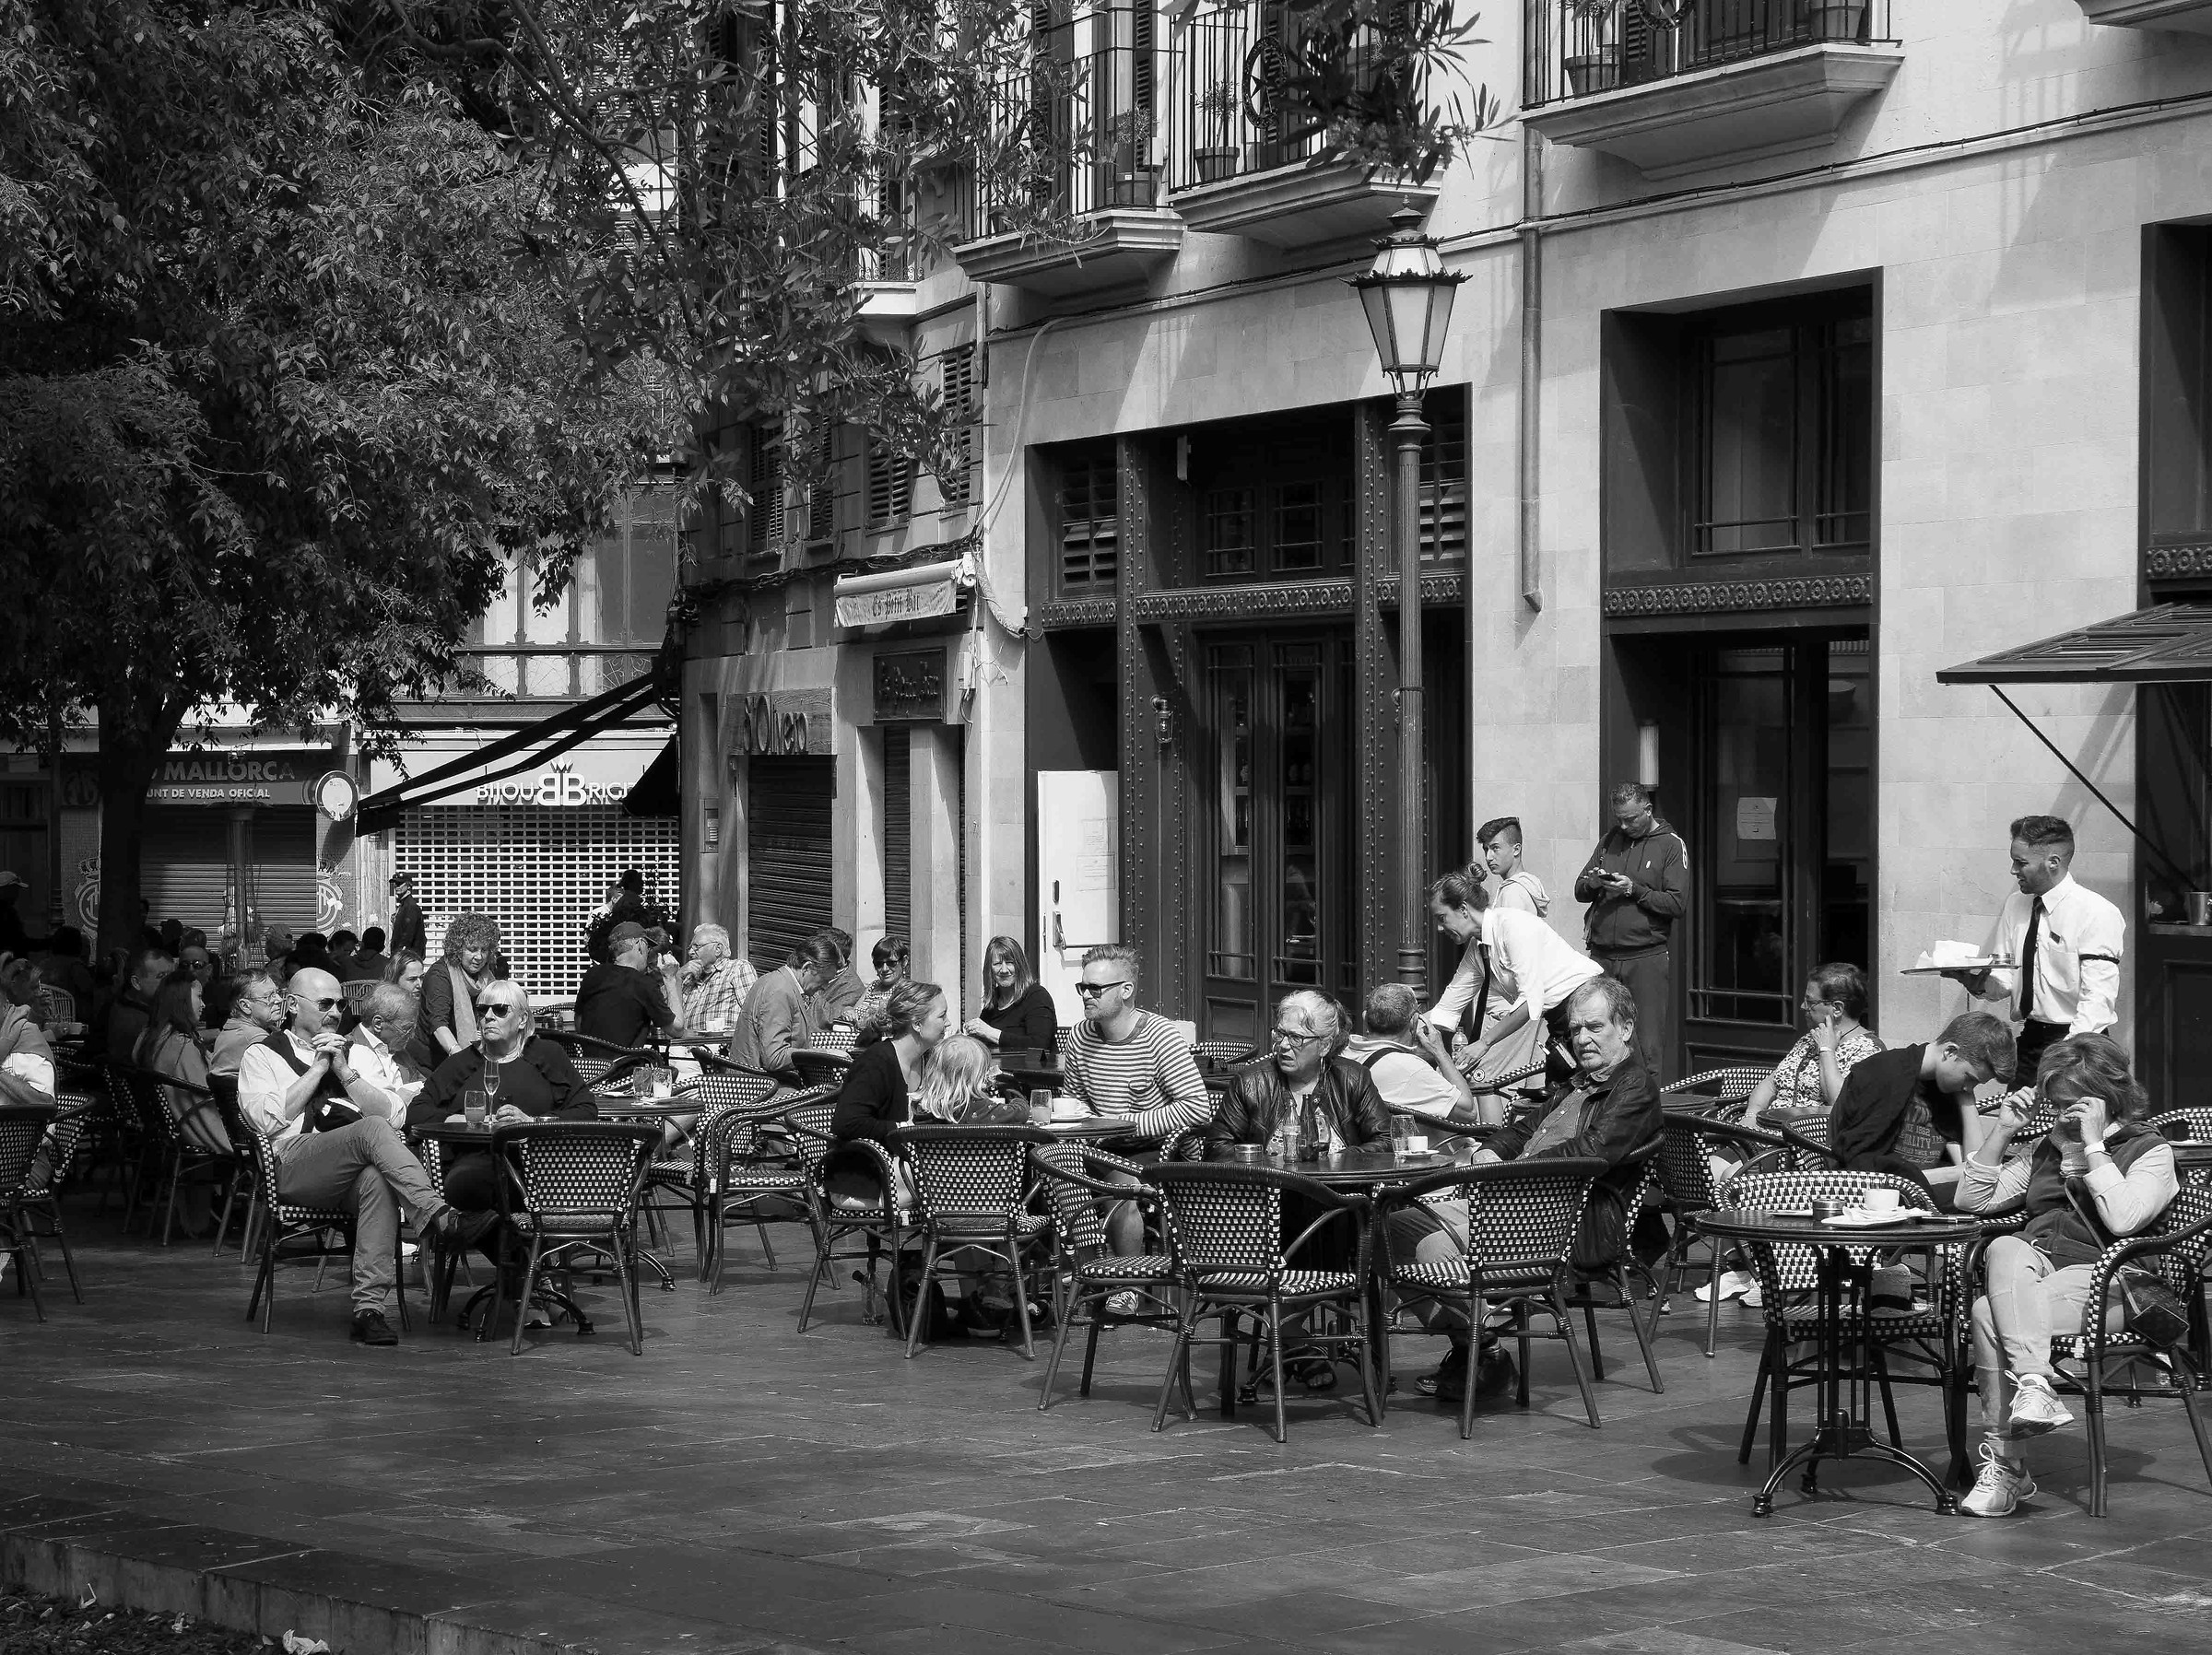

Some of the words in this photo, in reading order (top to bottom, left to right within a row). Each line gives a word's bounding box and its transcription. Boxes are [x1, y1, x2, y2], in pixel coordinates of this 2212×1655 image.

[163, 760, 296, 781] MALLORCA
[146, 788, 169, 799] UNT
[171, 788, 185, 799] DE
[187, 788, 225, 799] VENDA
[229, 788, 270, 799] OFICIAL
[476, 781, 535, 802] BIJOU
